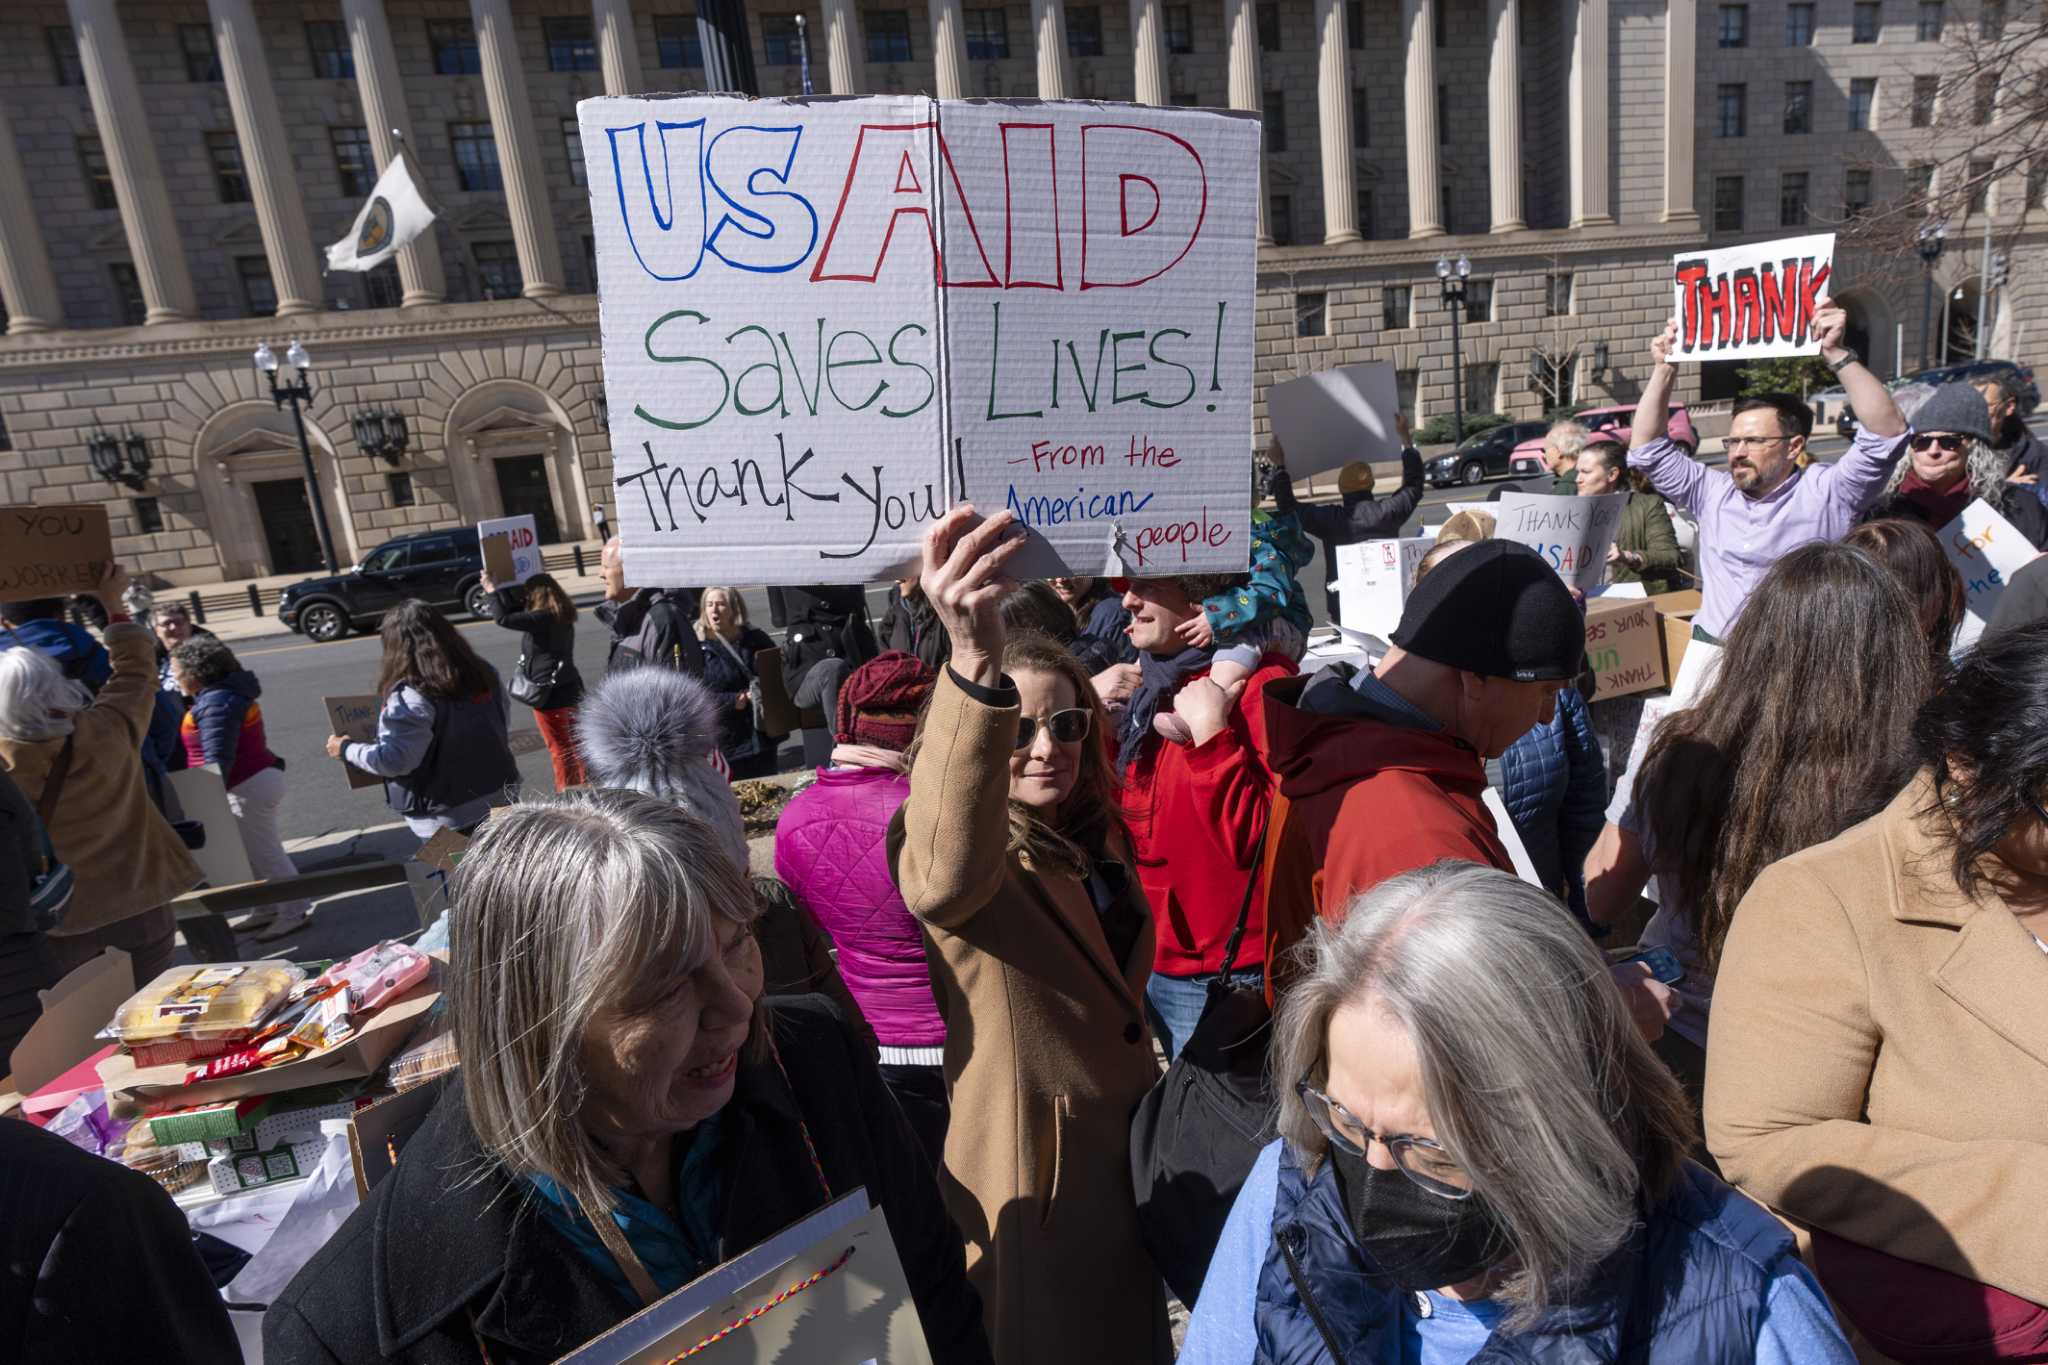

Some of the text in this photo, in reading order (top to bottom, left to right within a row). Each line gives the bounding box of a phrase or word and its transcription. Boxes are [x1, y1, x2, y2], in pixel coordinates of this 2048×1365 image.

[605, 118, 1207, 290] USAID
[1676, 256, 1832, 354] THANK
[634, 302, 1227, 430] Saves LIVES!
[1124, 435, 1182, 468] the
[16, 513, 84, 536] YOU
[1006, 483, 1154, 537] American
[1512, 503, 1581, 532] THANK
[1135, 505, 1232, 567] people
[1951, 524, 1995, 560] for
[1614, 608, 1650, 633] YOUR
[1605, 663, 1657, 690] THANK
